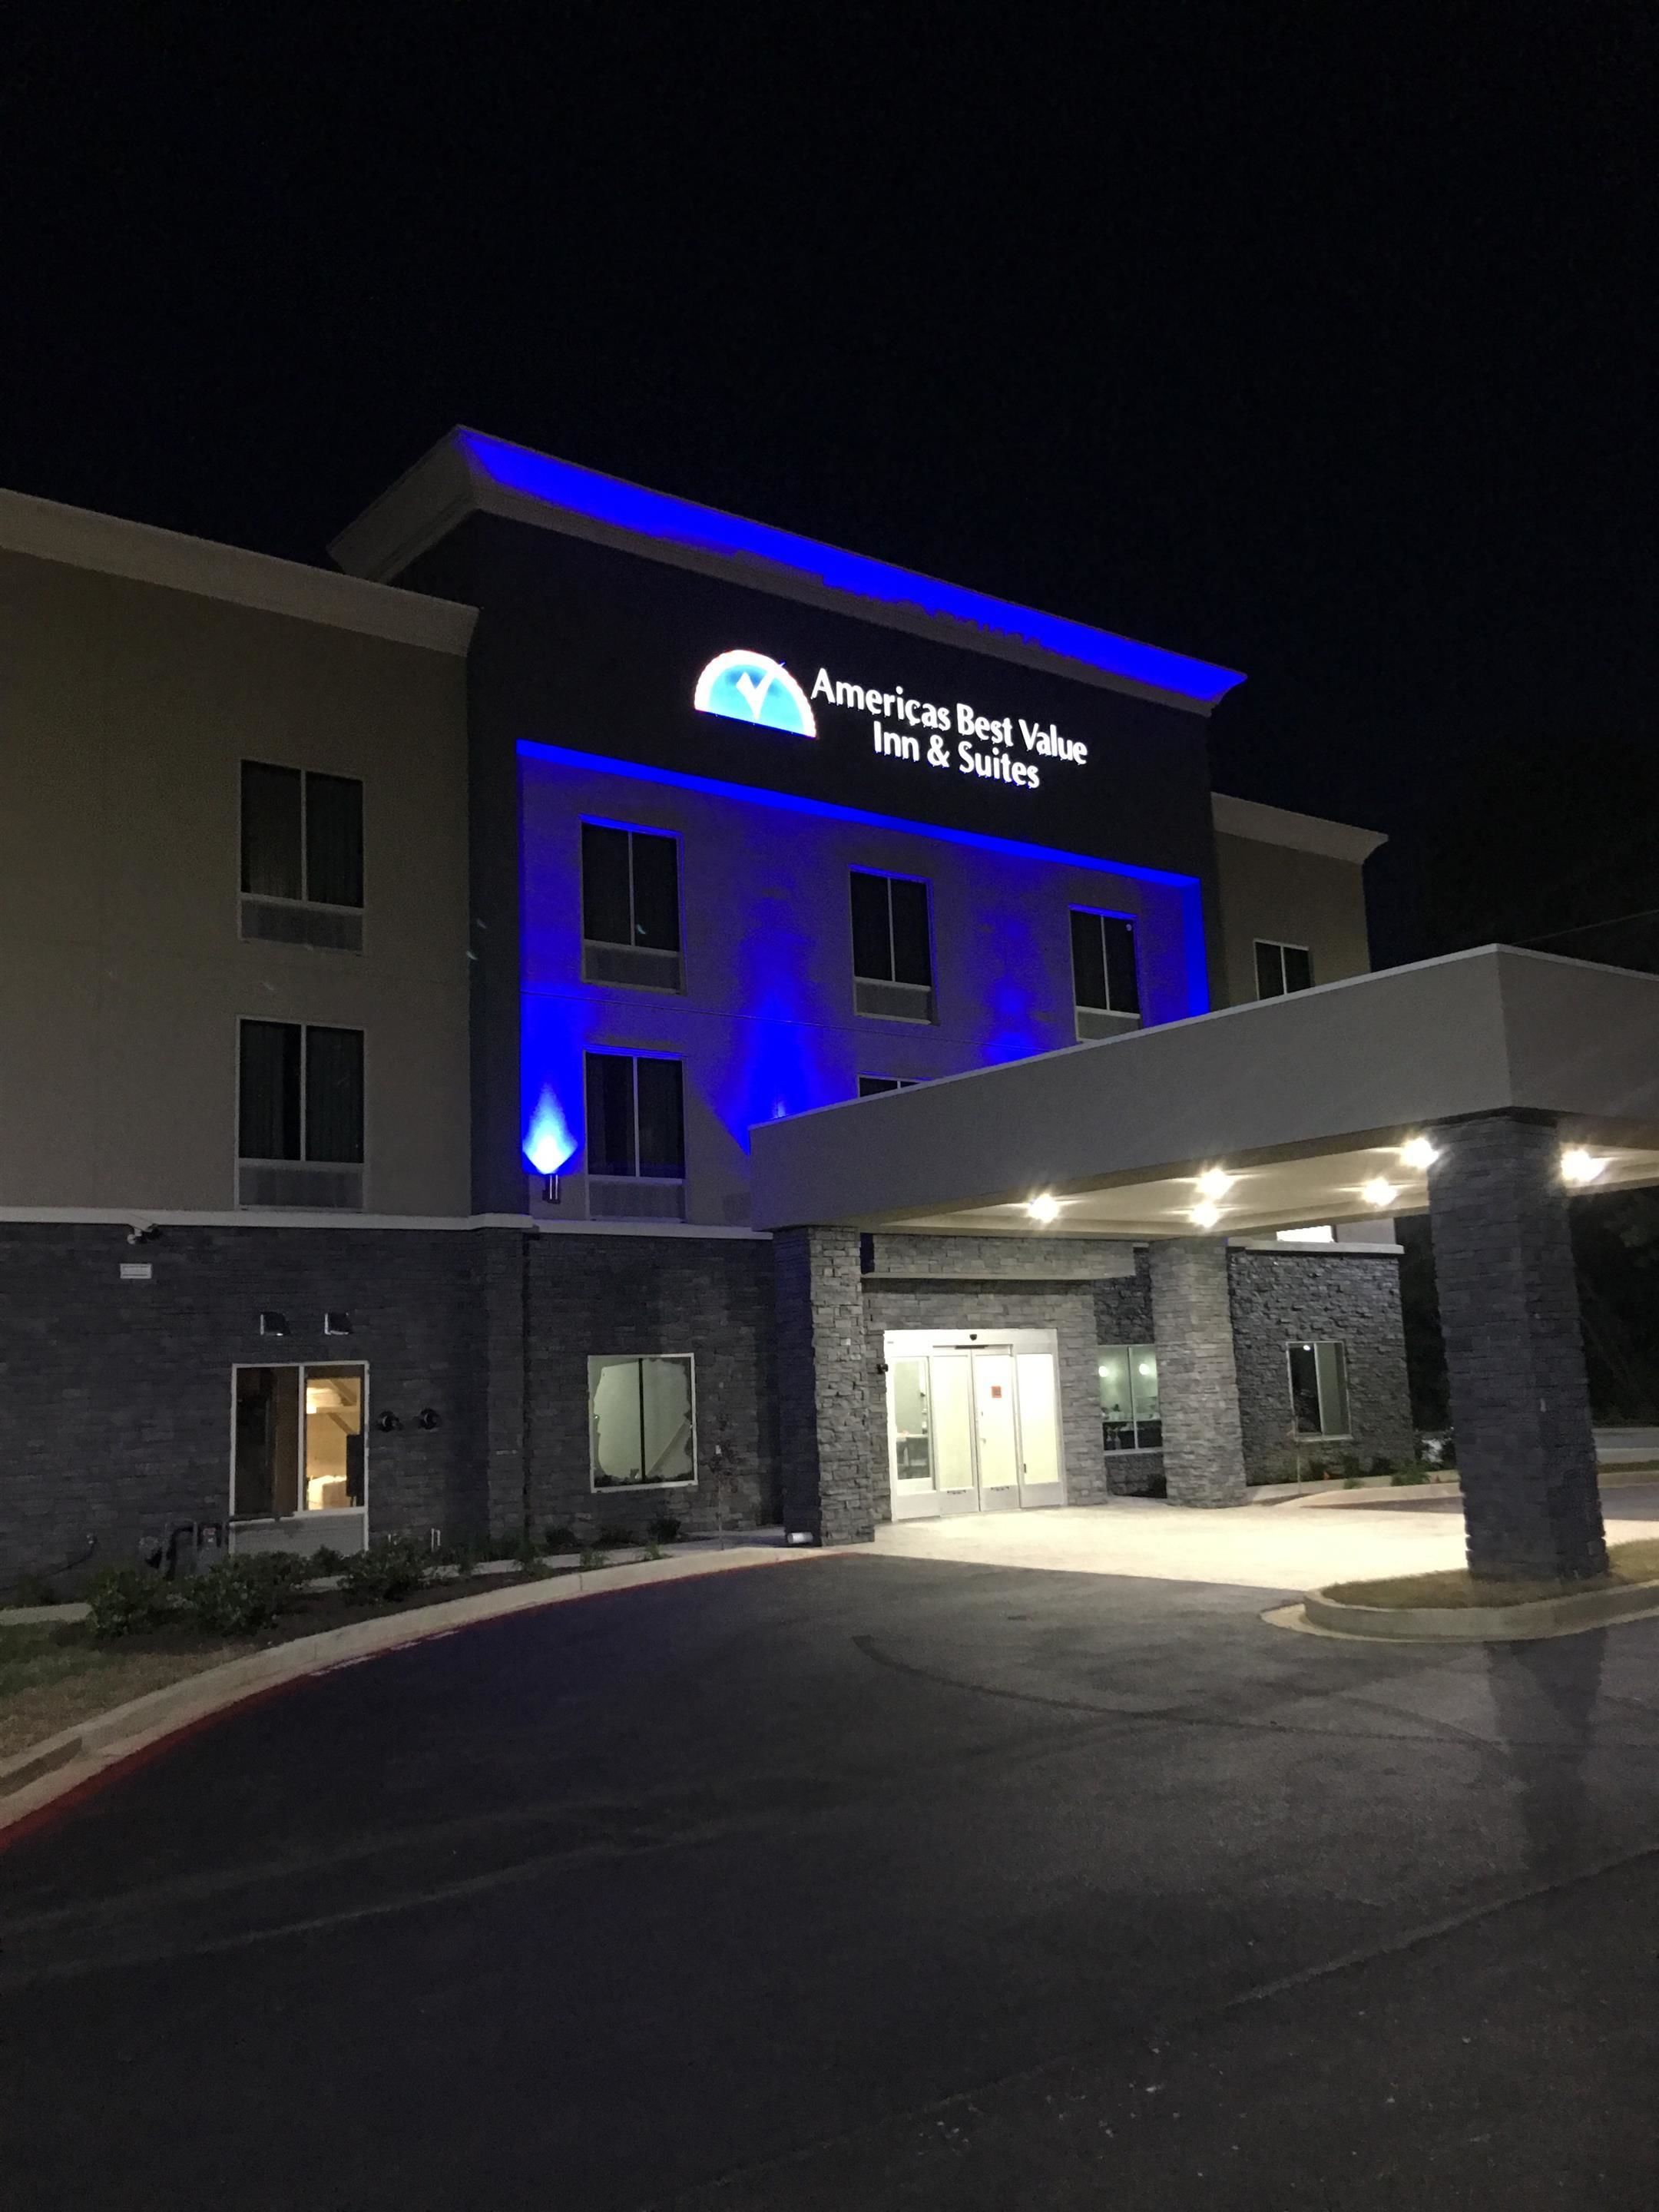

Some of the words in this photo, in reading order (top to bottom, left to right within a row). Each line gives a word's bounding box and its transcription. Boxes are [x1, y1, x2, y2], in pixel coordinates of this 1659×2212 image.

[810, 667, 952, 732] Americas
[956, 703, 1014, 748] Best
[1018, 718, 1088, 766] Value
[873, 720, 920, 763] Inn
[926, 733, 951, 769] &
[958, 740, 1041, 790] Suites
